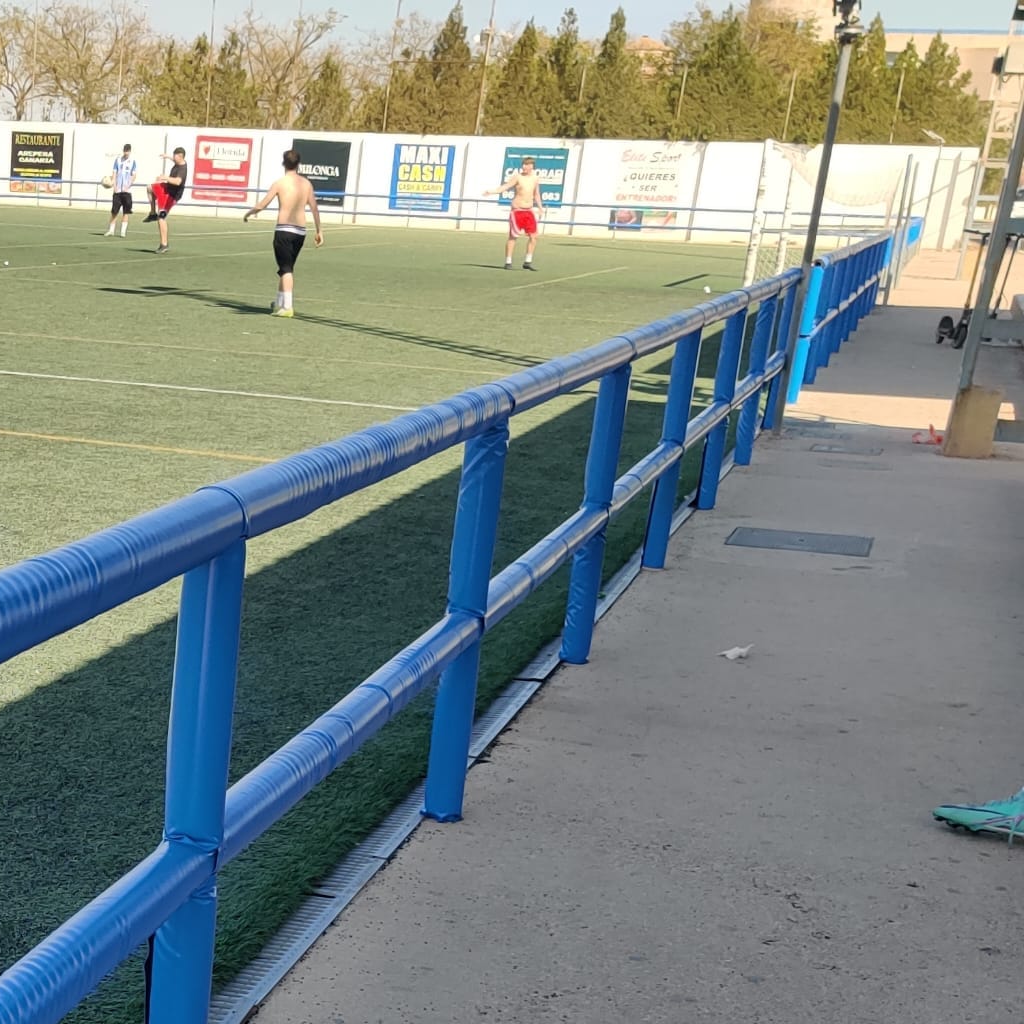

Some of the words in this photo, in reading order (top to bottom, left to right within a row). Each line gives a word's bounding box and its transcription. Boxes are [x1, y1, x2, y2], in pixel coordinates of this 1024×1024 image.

[400, 145, 449, 165] MAXI
[297, 164, 340, 177] MILONGA
[398, 164, 447, 182] CASH
